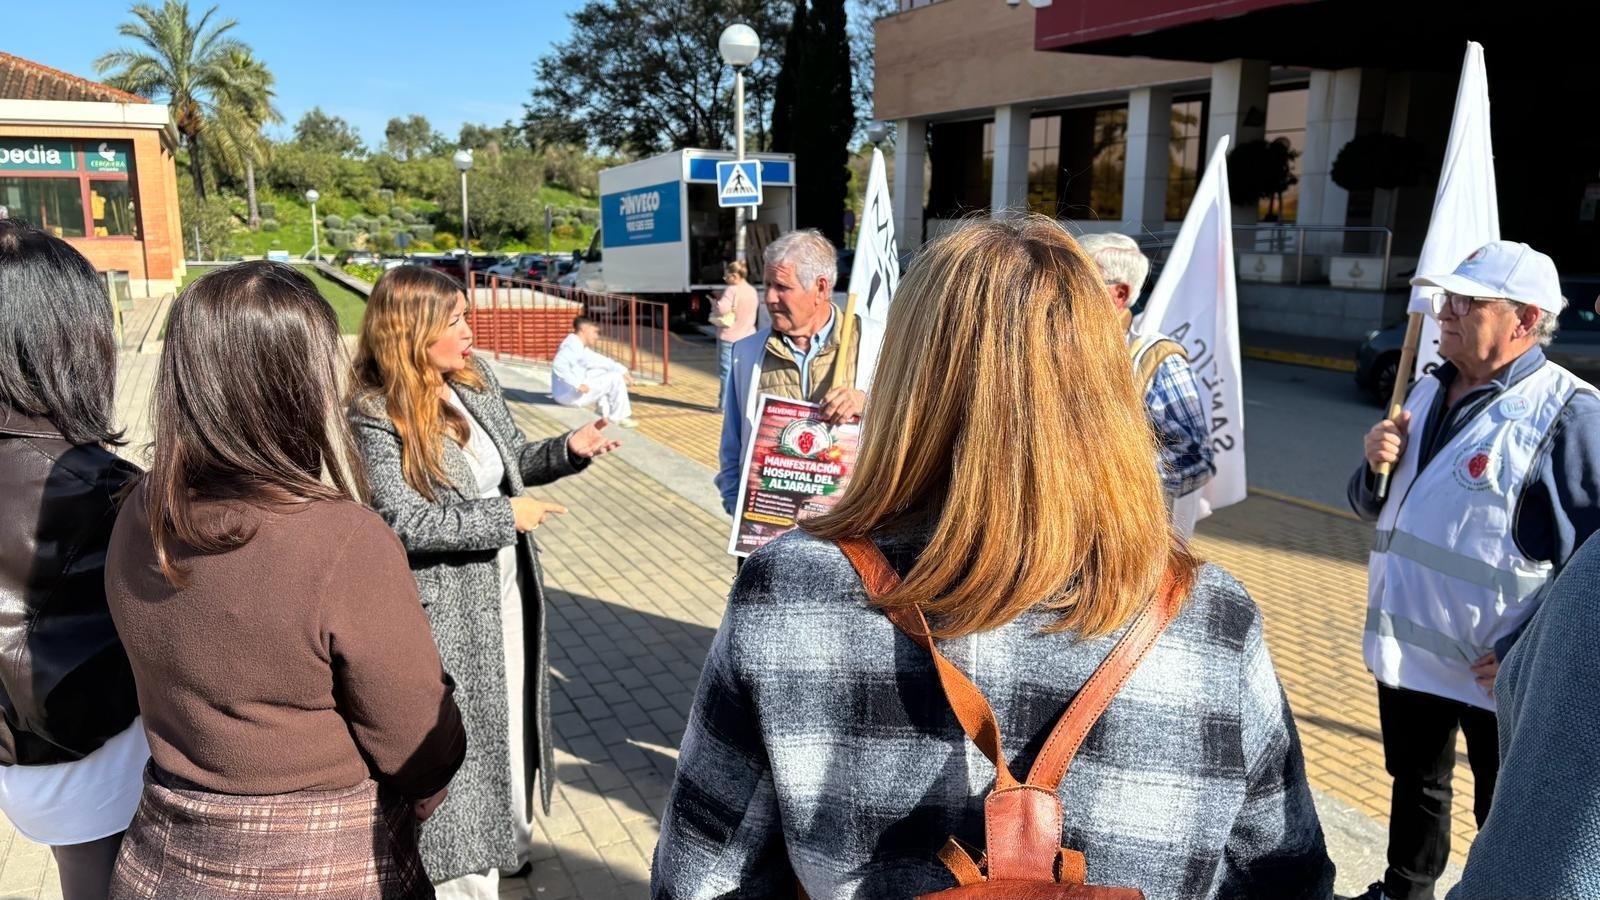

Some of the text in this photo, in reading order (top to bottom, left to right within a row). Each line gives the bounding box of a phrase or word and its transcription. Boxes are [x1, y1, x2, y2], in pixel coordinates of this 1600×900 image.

[767, 405, 798, 418] SALVEMOS
[764, 455, 841, 474] MANIFESTACIÓN
[763, 467, 834, 485] HOSPITAL DEL
[768, 479, 824, 495] ALJARAFE
